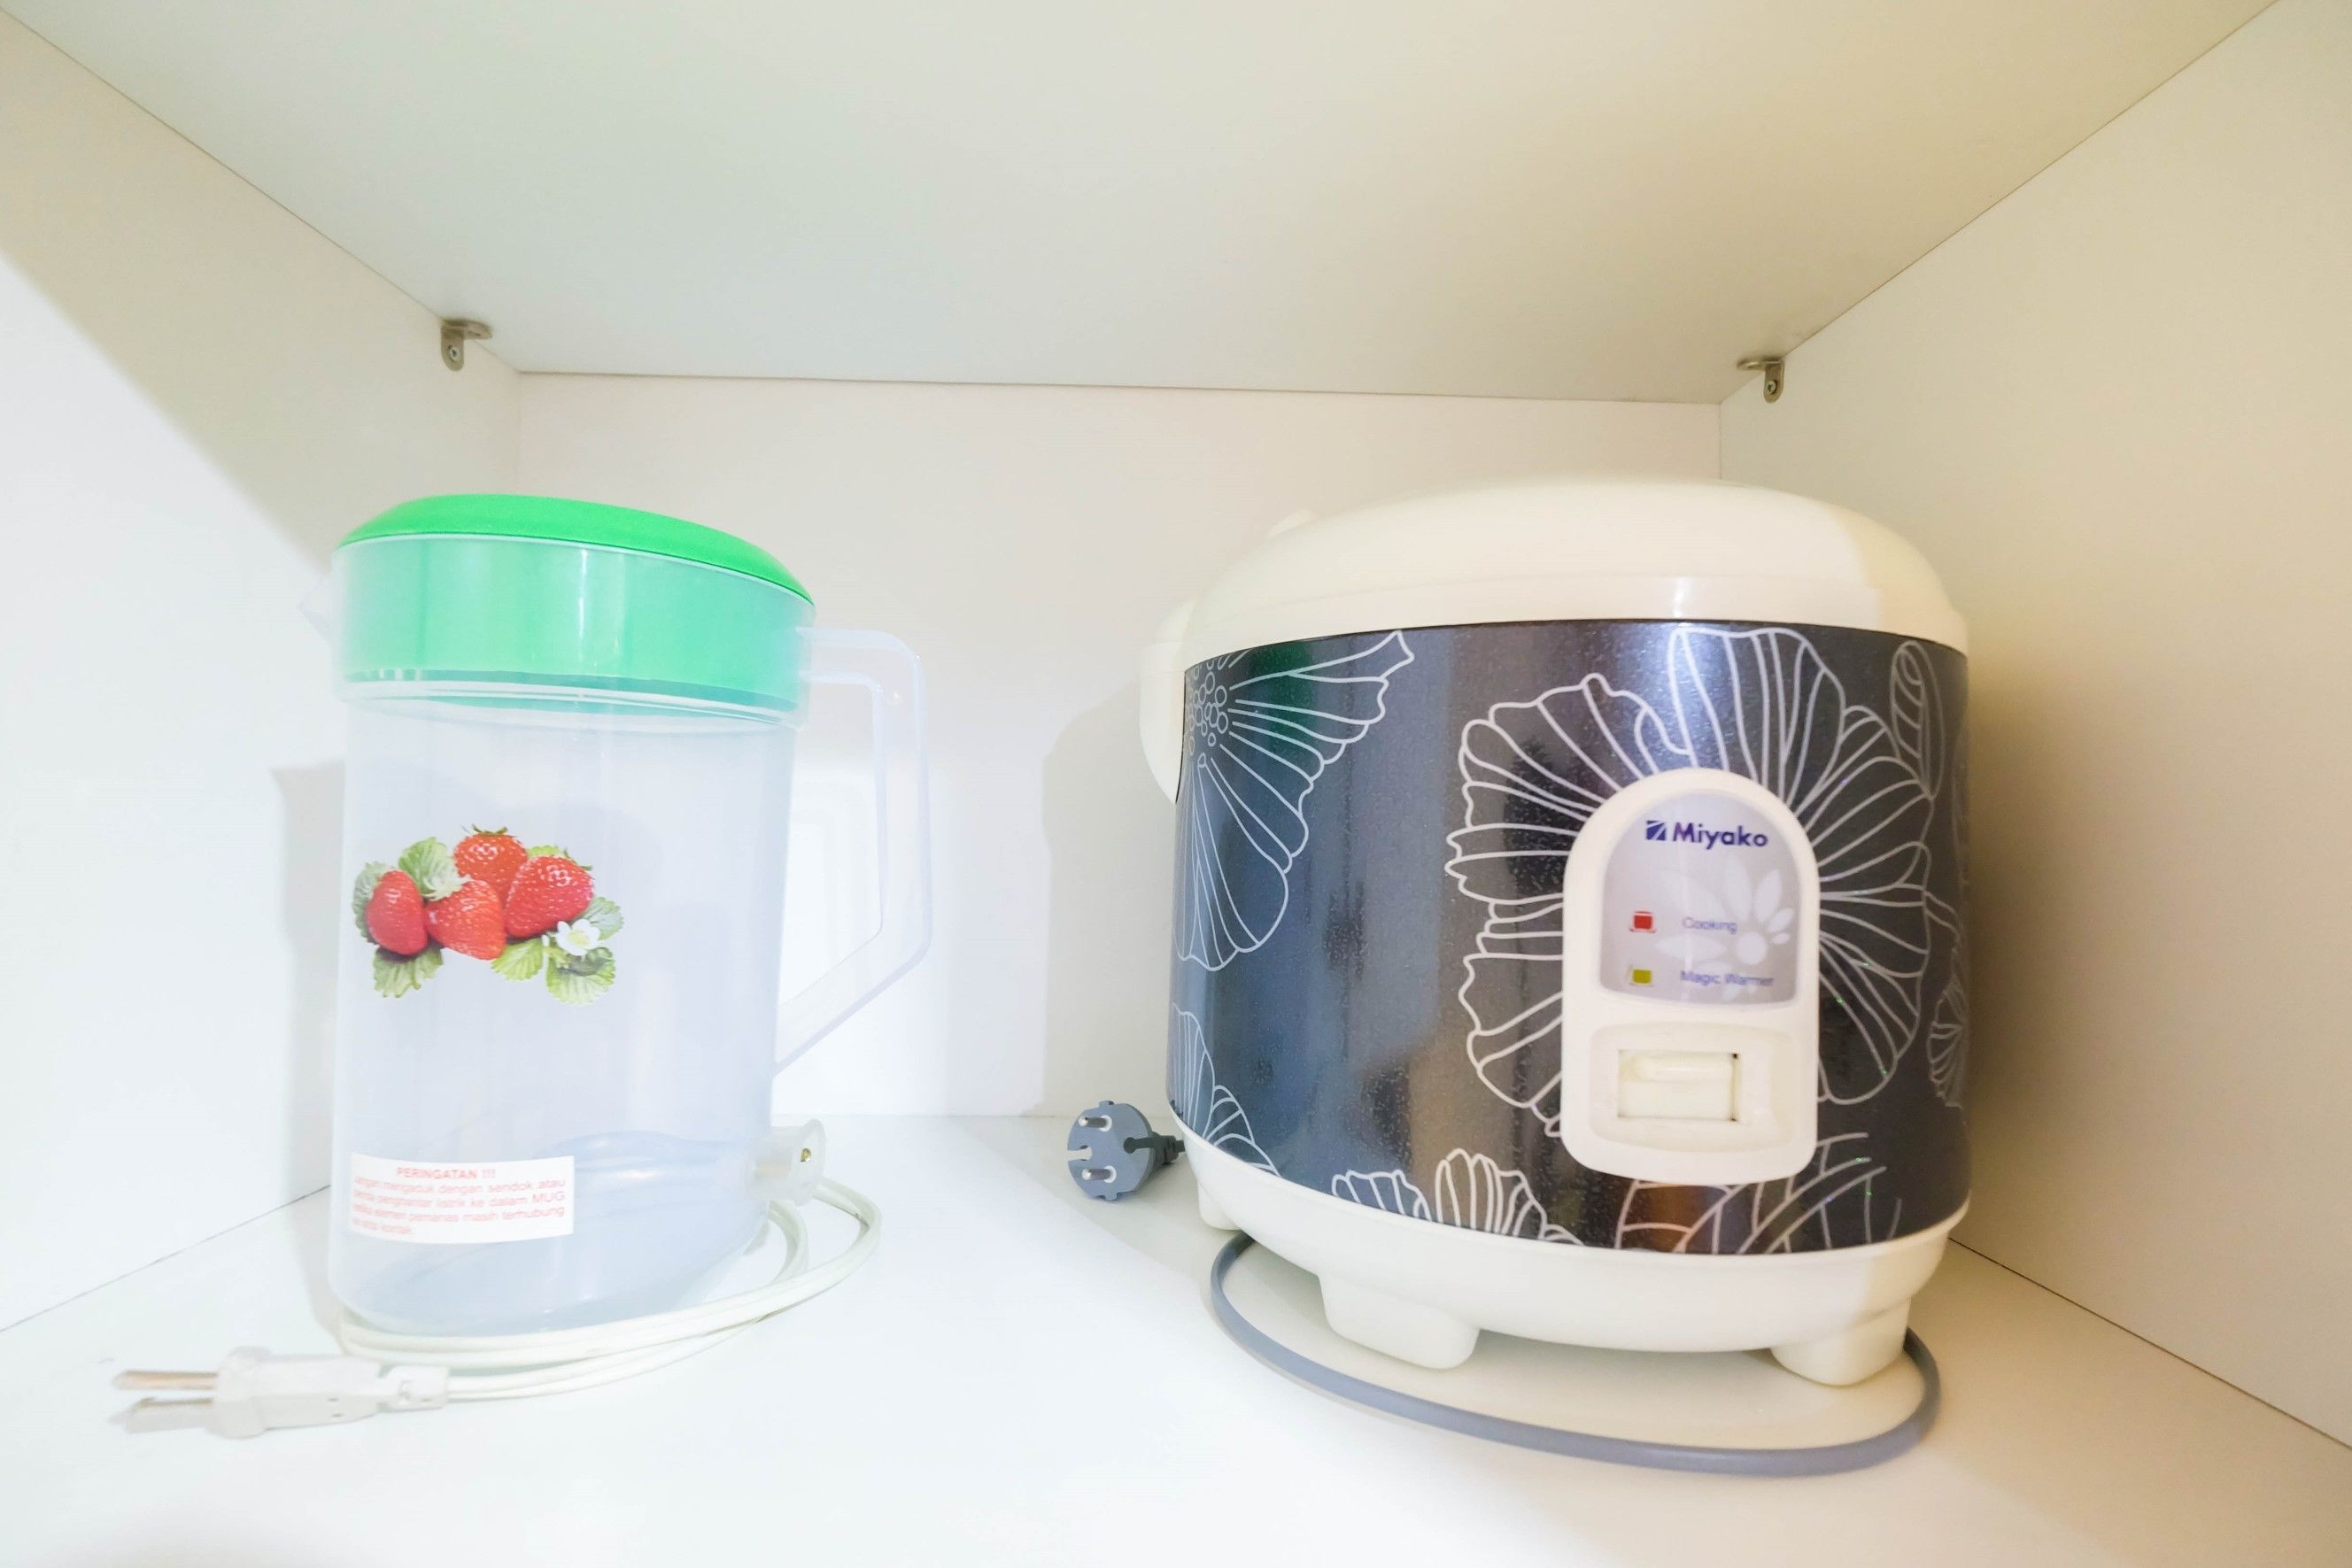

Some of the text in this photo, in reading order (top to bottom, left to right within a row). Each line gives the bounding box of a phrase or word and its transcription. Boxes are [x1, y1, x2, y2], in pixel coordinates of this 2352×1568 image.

[1673, 822, 1769, 850] Miyako
[1683, 917, 1737, 935] Cooking
[1680, 969, 1721, 986] Magic
[397, 1167, 477, 1179] PERINGATAN
[438, 1183, 484, 1195] dengan
[488, 1180, 533, 1193] sendok
[538, 1178, 566, 1190] atau
[532, 1190, 566, 1204] MUG
